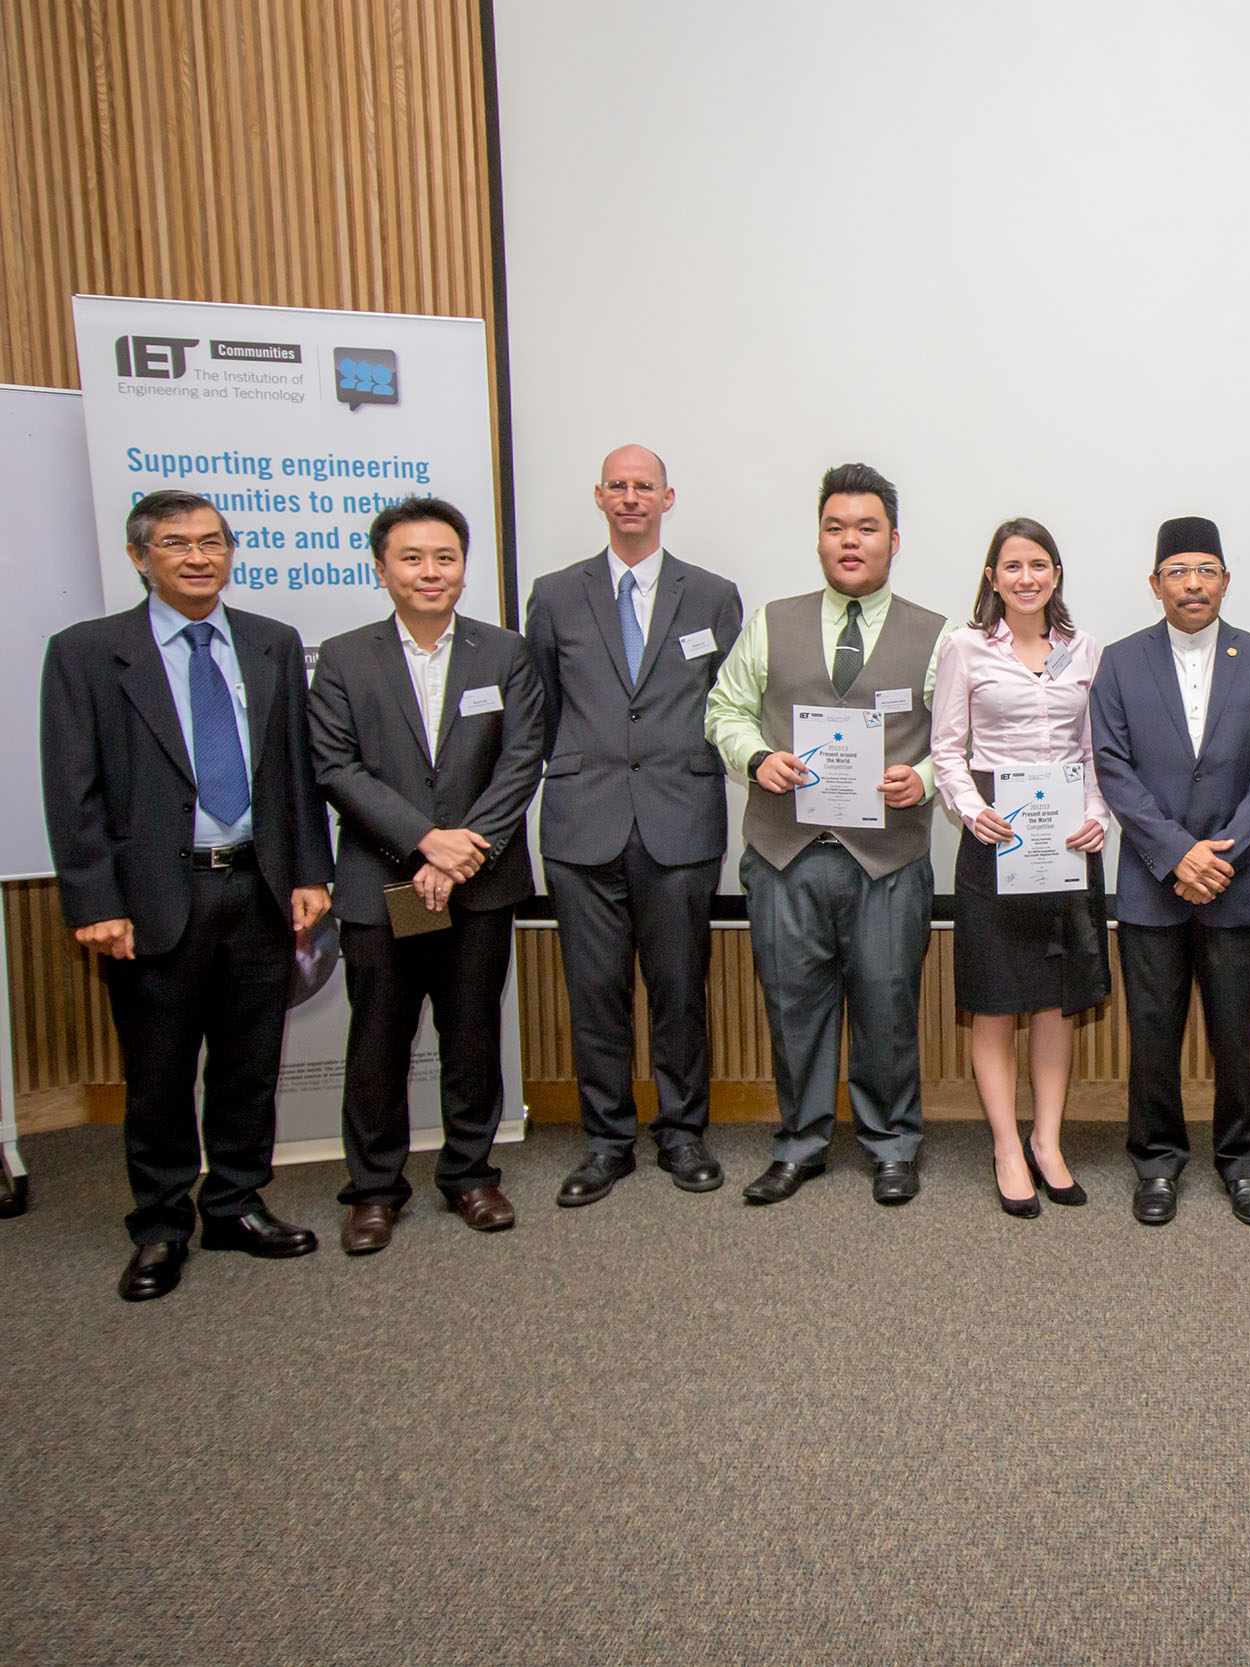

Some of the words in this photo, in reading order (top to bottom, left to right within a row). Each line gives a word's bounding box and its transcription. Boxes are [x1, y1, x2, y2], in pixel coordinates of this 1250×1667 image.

[115, 335, 200, 379] IET
[218, 344, 295, 360] Communities
[194, 369, 220, 381] The
[224, 371, 288, 385] Institution
[292, 374, 304, 385] of
[118, 382, 200, 399] Engineering
[203, 387, 228, 398] and
[232, 387, 305, 404] Technology
[126, 447, 273, 480] Supporting
[282, 454, 430, 484] engineering
[309, 491, 333, 513] to
[295, 527, 339, 550] and
